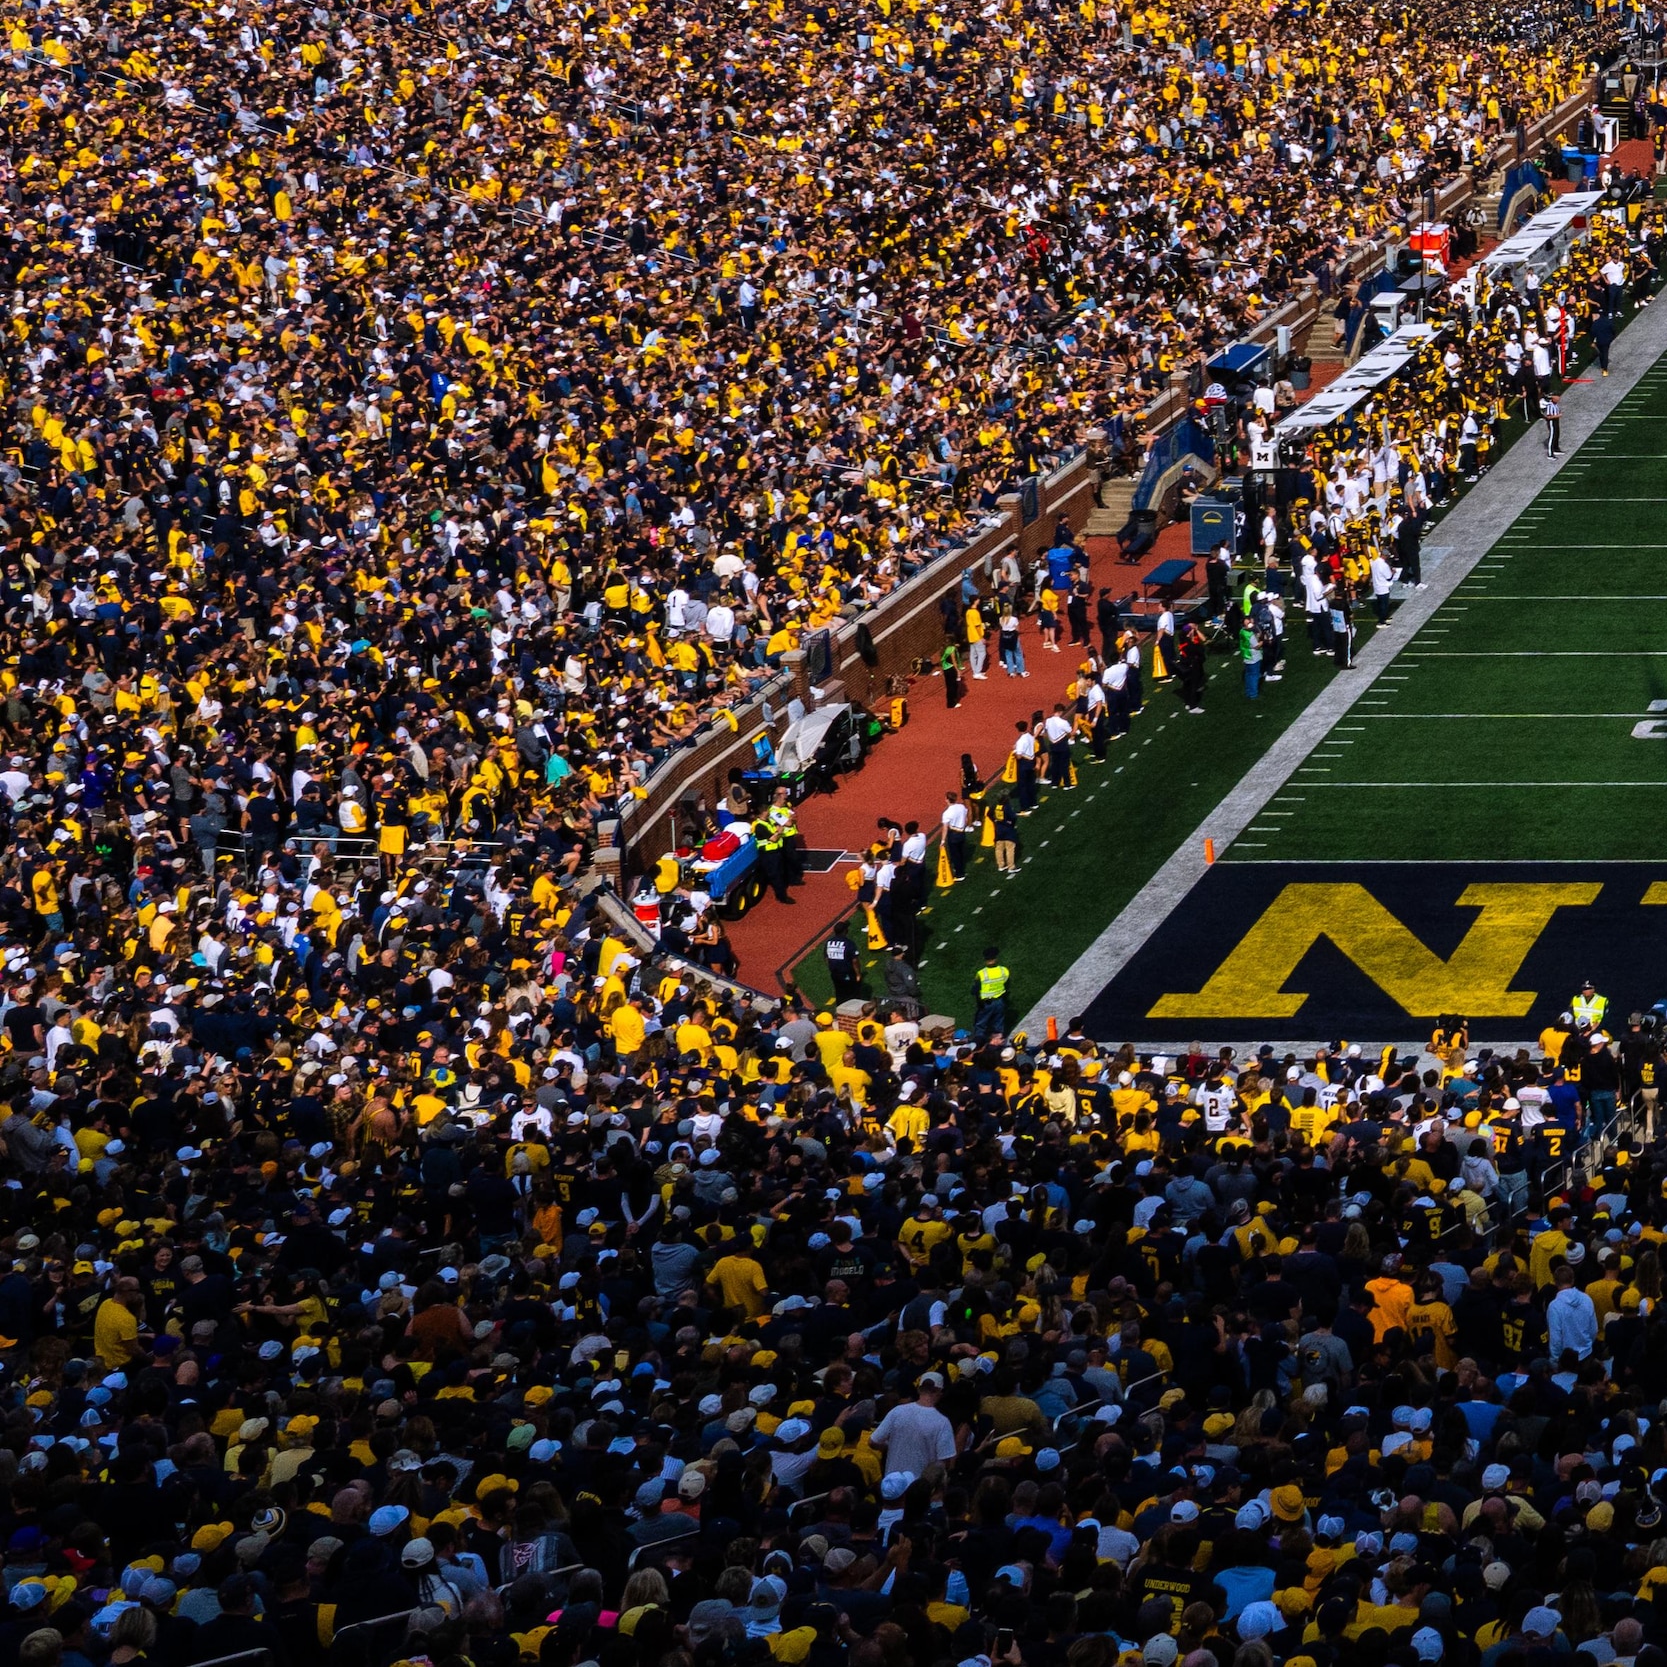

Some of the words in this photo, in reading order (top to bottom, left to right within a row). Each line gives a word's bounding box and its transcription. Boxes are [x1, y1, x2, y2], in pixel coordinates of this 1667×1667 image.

[1461, 284, 1471, 294] M
[1257, 452, 1268, 462] M
[869, 934, 878, 942] M
[898, 1038, 910, 1047] M
[1081, 1098, 1091, 1116] 9
[1208, 1098, 1219, 1116] 2
[1550, 1137, 1561, 1156] 2
[560, 1182, 571, 1203] 9
[912, 1230, 924, 1253] 4
[830, 1264, 864, 1277] MODELO
[1503, 1323, 1523, 1352] 97
[1144, 1577, 1191, 1594] UNDERWOOD
